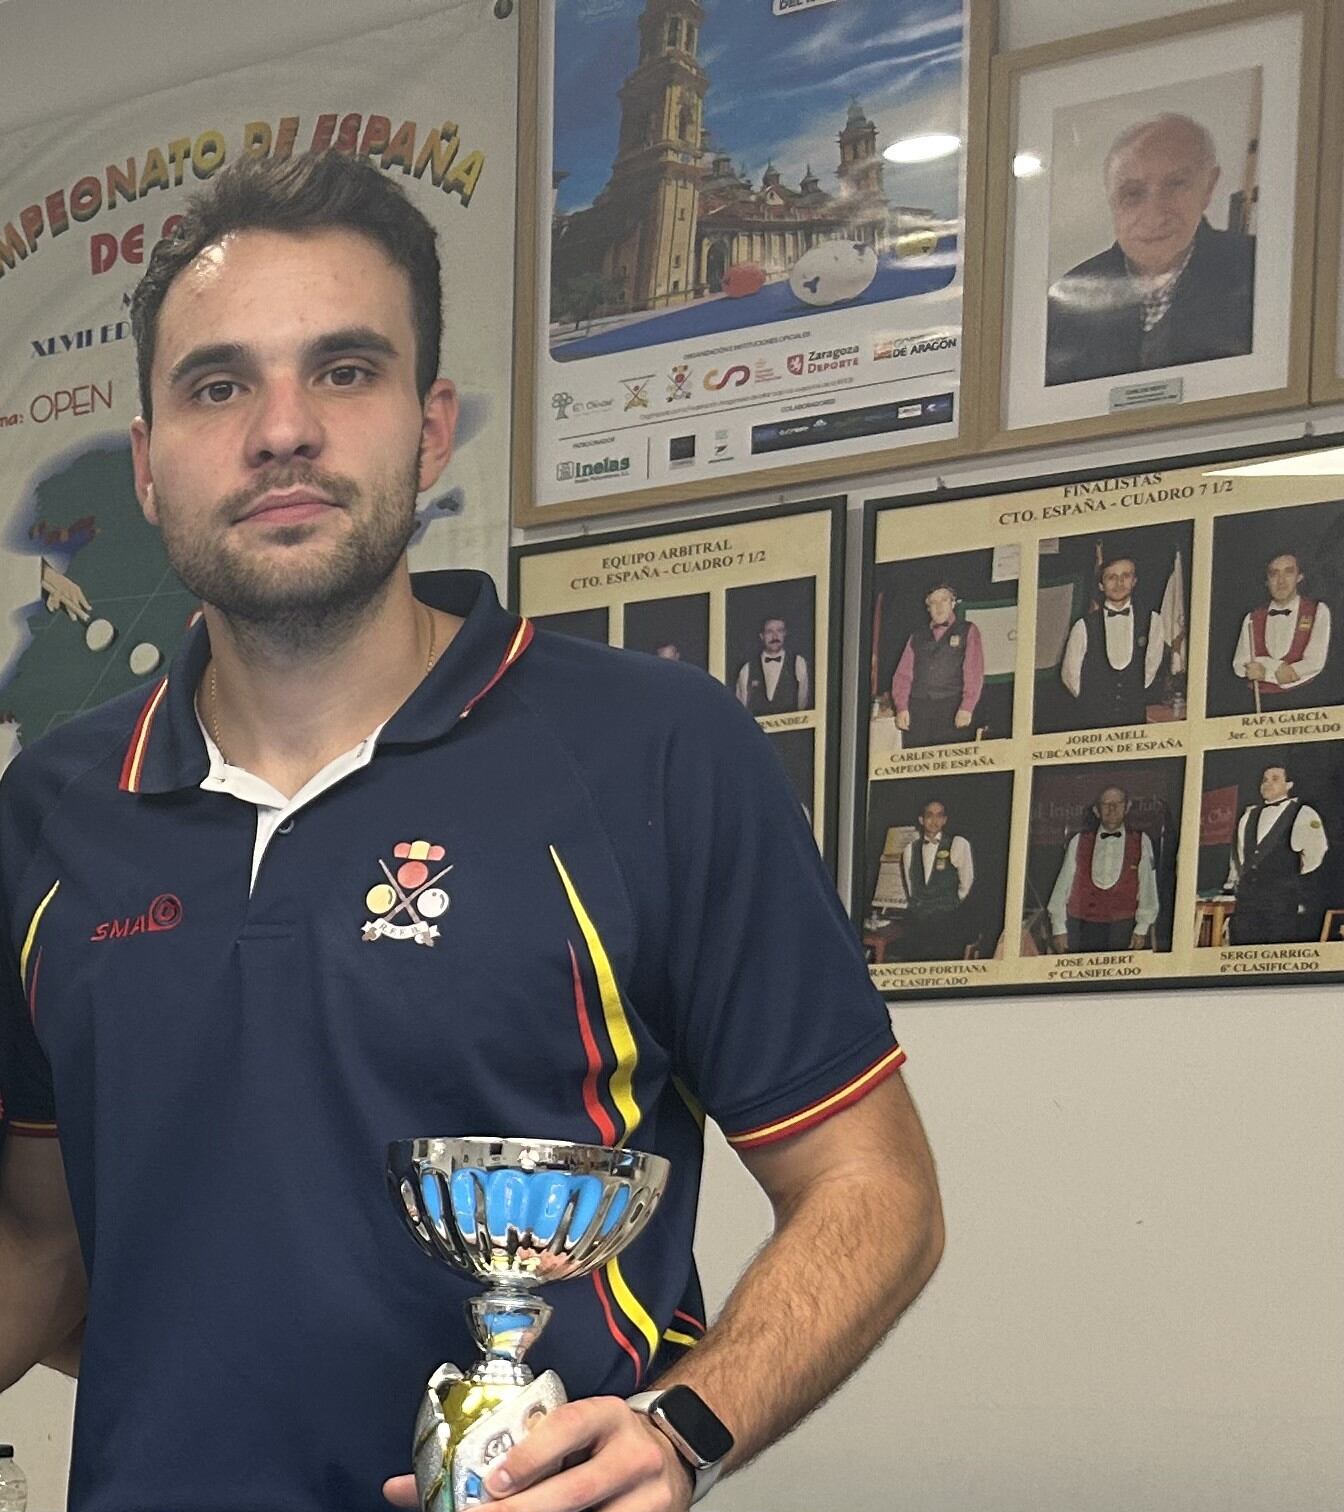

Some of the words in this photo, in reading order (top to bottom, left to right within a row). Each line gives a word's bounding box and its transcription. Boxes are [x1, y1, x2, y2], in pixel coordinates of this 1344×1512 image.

[310, 113, 485, 208] ESPAÑA
[91, 224, 144, 275] DE
[31, 329, 92, 358] XLVII
[808, 345, 859, 362] Zaragoza
[893, 347, 907, 358] DE
[808, 358, 859, 374] DEPORTE
[30, 380, 112, 423] OPEN
[1064, 473, 1162, 498] FINALISTAS
[999, 510, 1037, 525] CTO.
[1043, 498, 1107, 520] ESPAÑA
[1121, 486, 1194, 506] CUADRO
[1200, 484, 1207, 494] 7
[1213, 481, 1232, 493] 1/2
[602, 550, 655, 569] EQUIPO
[658, 539, 732, 561] ARBITRAL
[571, 576, 602, 590] CTO.
[607, 565, 660, 585] ESPAÑA
[672, 556, 733, 574] CUADRO
[738, 553, 744, 565] 7
[749, 550, 766, 562] 1/2
[1242, 714, 1275, 726] RAFA
[1066, 732, 1102, 744] JORDI
[1105, 730, 1147, 741] AMELL
[1254, 723, 1341, 738] CLASIFICADO
[890, 750, 935, 763] CARLES
[937, 746, 978, 758] TUSSET
[1032, 745, 1113, 760] SUBCAMPEON
[1117, 743, 1133, 753] DE
[1137, 737, 1183, 751] ESPAÑA
[874, 762, 930, 775] CAMPEON
[933, 760, 946, 770] DE
[950, 756, 995, 769] ESPAÑA
[1086, 955, 1134, 965] ALBERT
[1220, 950, 1258, 960] SERGI
[1261, 949, 1320, 959] GARRIGA
[871, 966, 926, 976] RANCISCO
[929, 964, 986, 975] FORTIANA
[1061, 967, 1141, 979] CLASIFICADO
[1234, 961, 1319, 972] CLASIFICADO
[893, 977, 968, 987] CLASIFICADO
